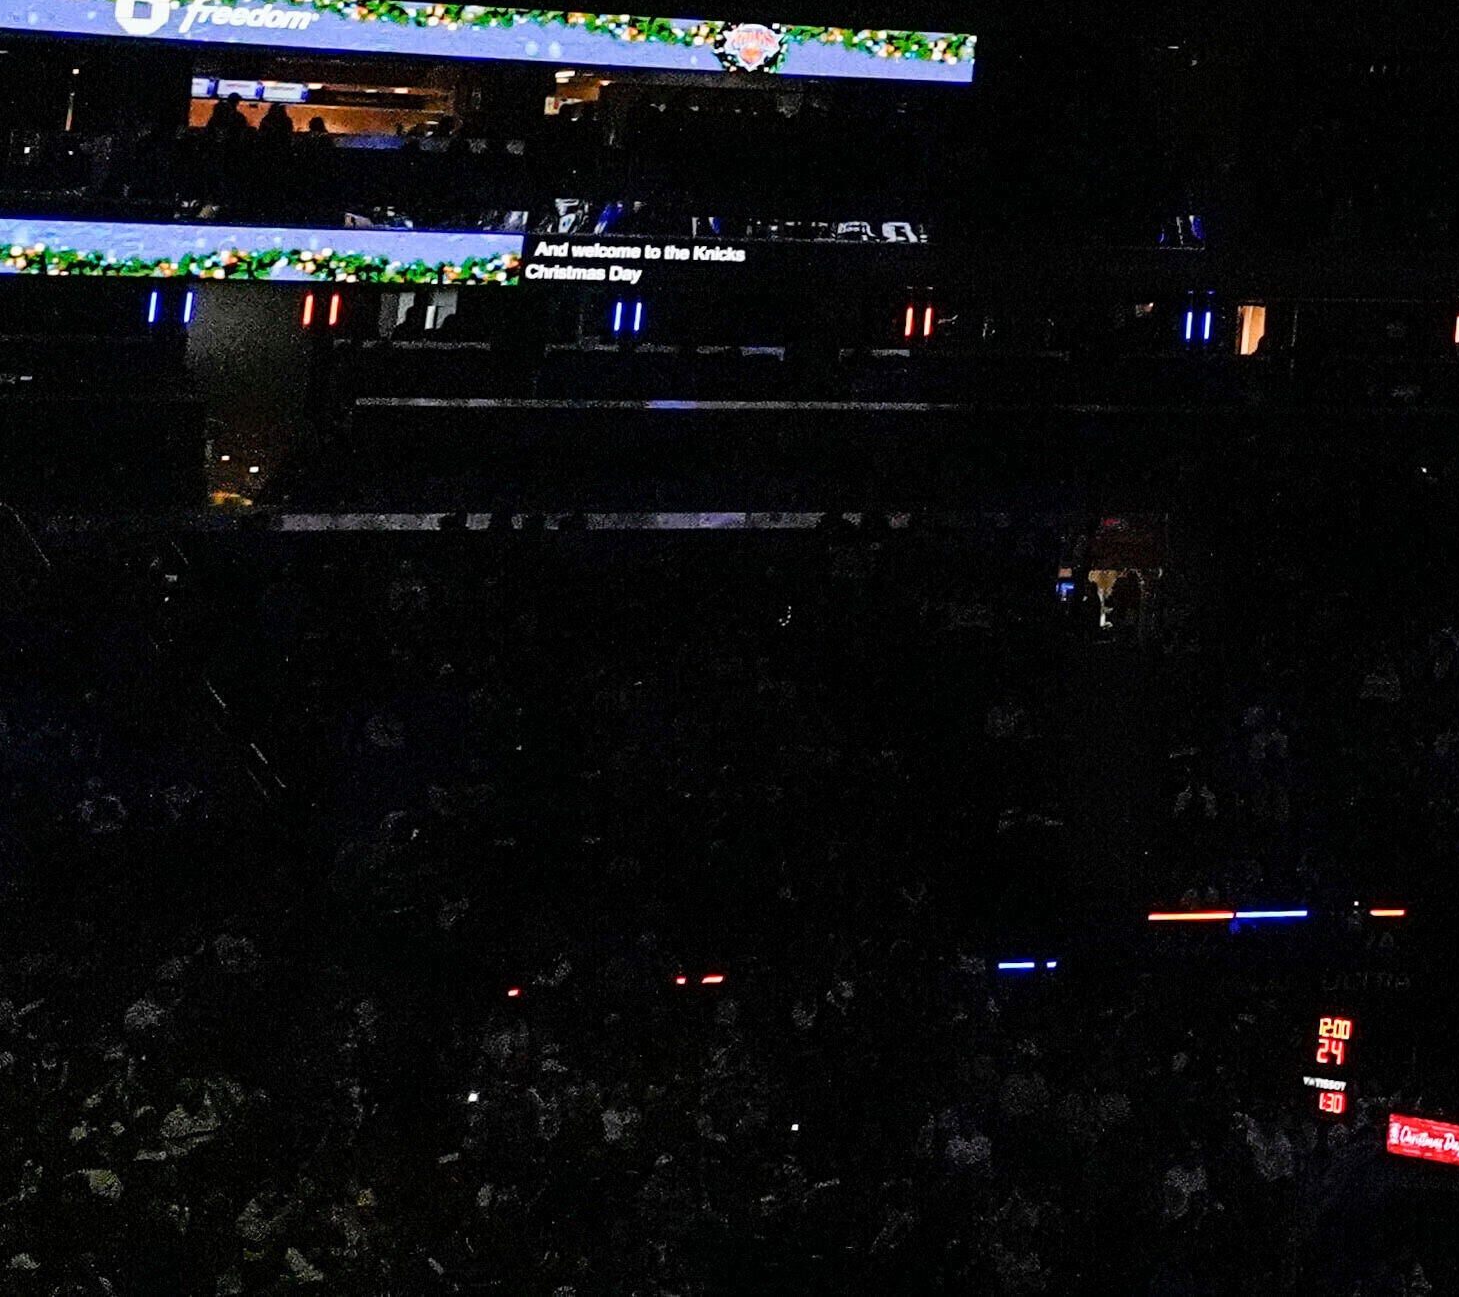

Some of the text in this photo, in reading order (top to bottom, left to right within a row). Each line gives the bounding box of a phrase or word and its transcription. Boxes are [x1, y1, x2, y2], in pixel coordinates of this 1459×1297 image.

[534, 242, 746, 262] And welcome to the Knicks
[525, 264, 643, 285] Christmas Day
[1318, 1017, 1351, 1040] 12:00
[1316, 1038, 1344, 1065] 24
[1316, 1078, 1347, 1091] TISSOT
[1318, 1091, 1345, 1114] 1:30
